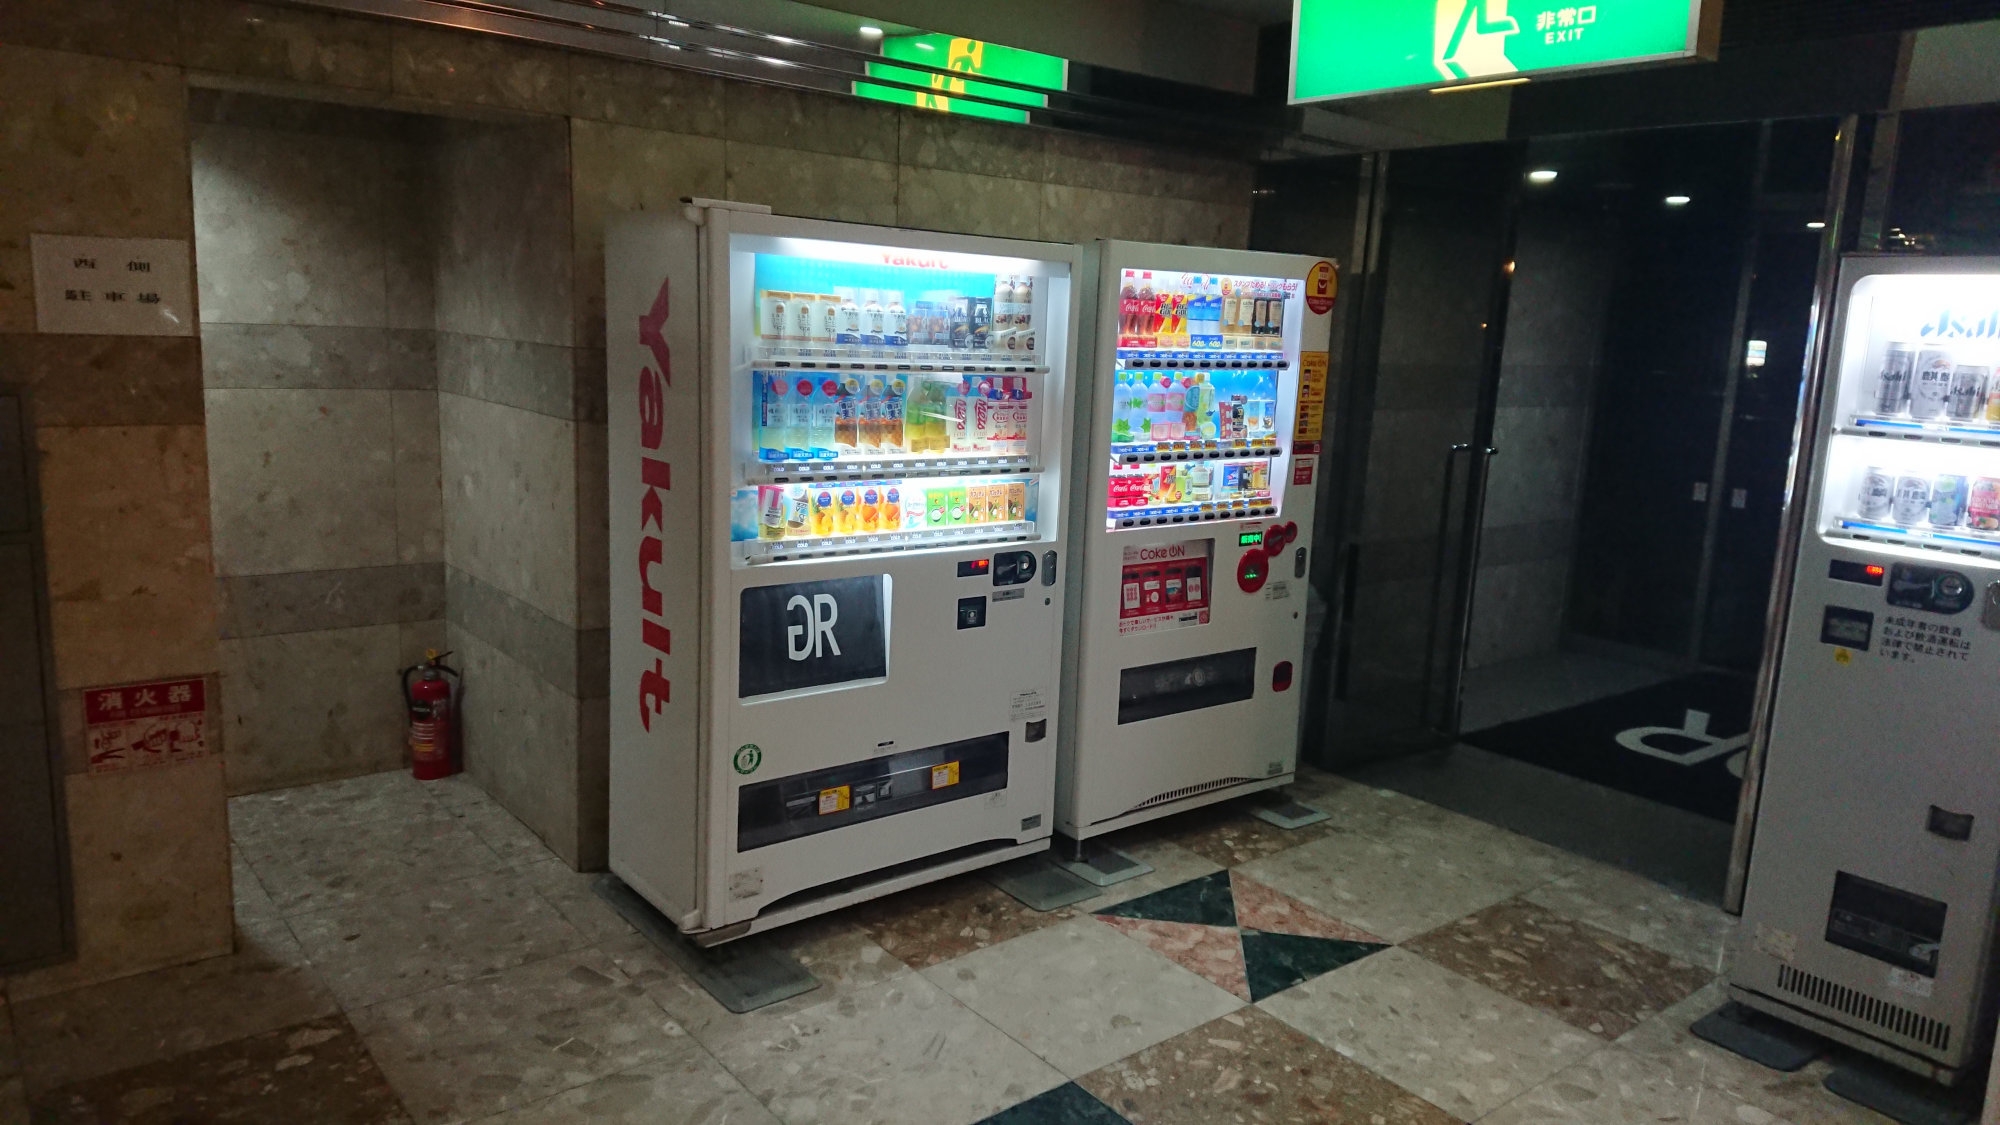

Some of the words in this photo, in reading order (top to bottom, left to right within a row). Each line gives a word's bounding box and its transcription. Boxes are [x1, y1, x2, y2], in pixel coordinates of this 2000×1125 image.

[1536, 5, 1597, 31] 非常口
[1545, 28, 1584, 46] EXIT
[65, 289, 160, 304] 駐車場
[639, 276, 671, 734] Yakult
[1140, 547, 1167, 561] Coke
[1883, 626, 1970, 650] および飲酒運転は
[1885, 616, 1962, 637] 未成年者の飲酒
[1881, 637, 1968, 661] 法律で禁止されて
[97, 684, 193, 711] 消火器
